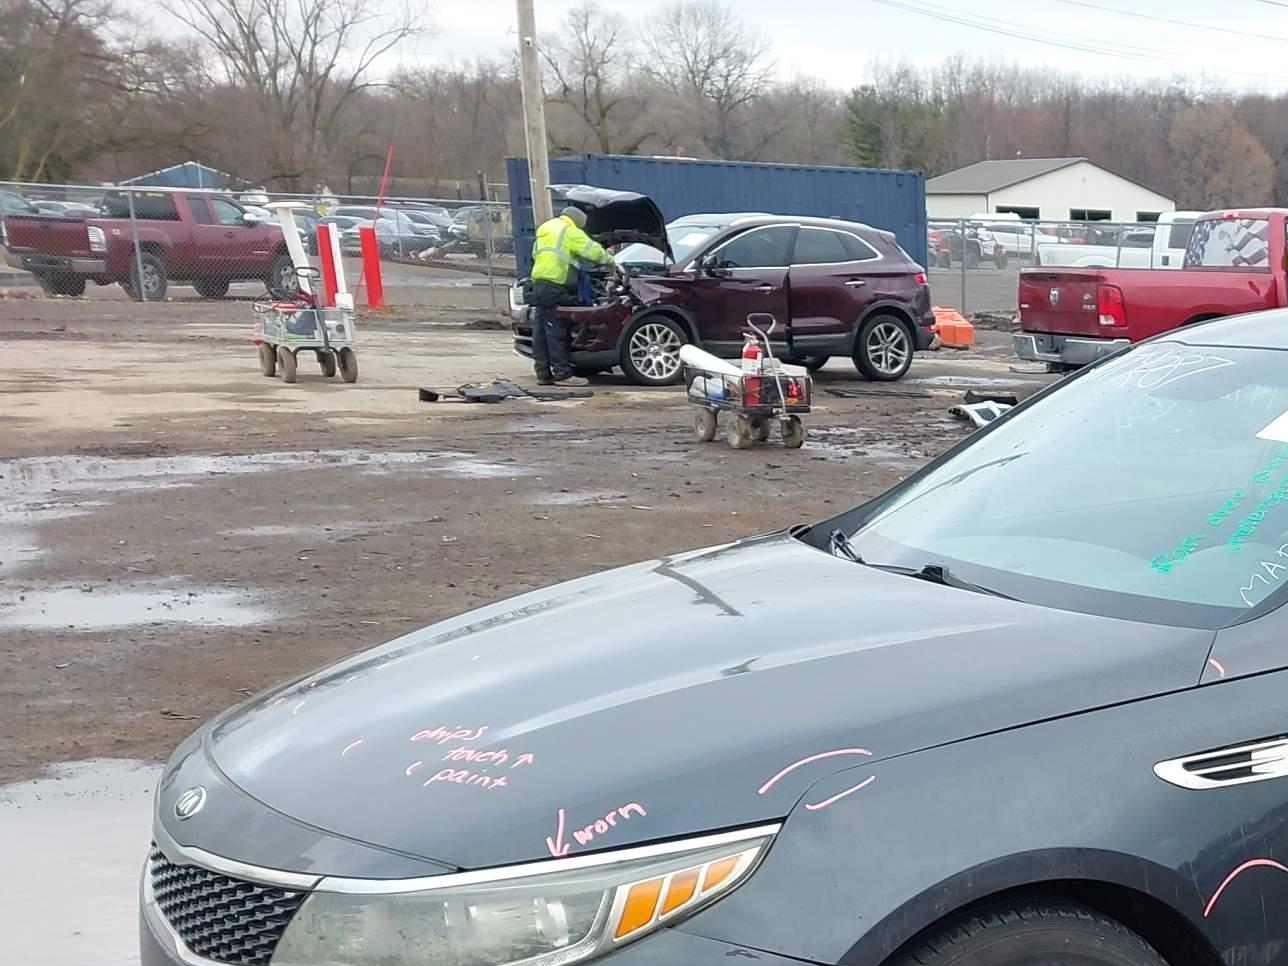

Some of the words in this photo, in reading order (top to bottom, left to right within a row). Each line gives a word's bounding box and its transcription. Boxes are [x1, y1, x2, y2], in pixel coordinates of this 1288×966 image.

[410, 725, 488, 744] chips
[441, 747, 508, 766] touch
[423, 768, 507, 789] paint
[572, 802, 648, 845] worn
